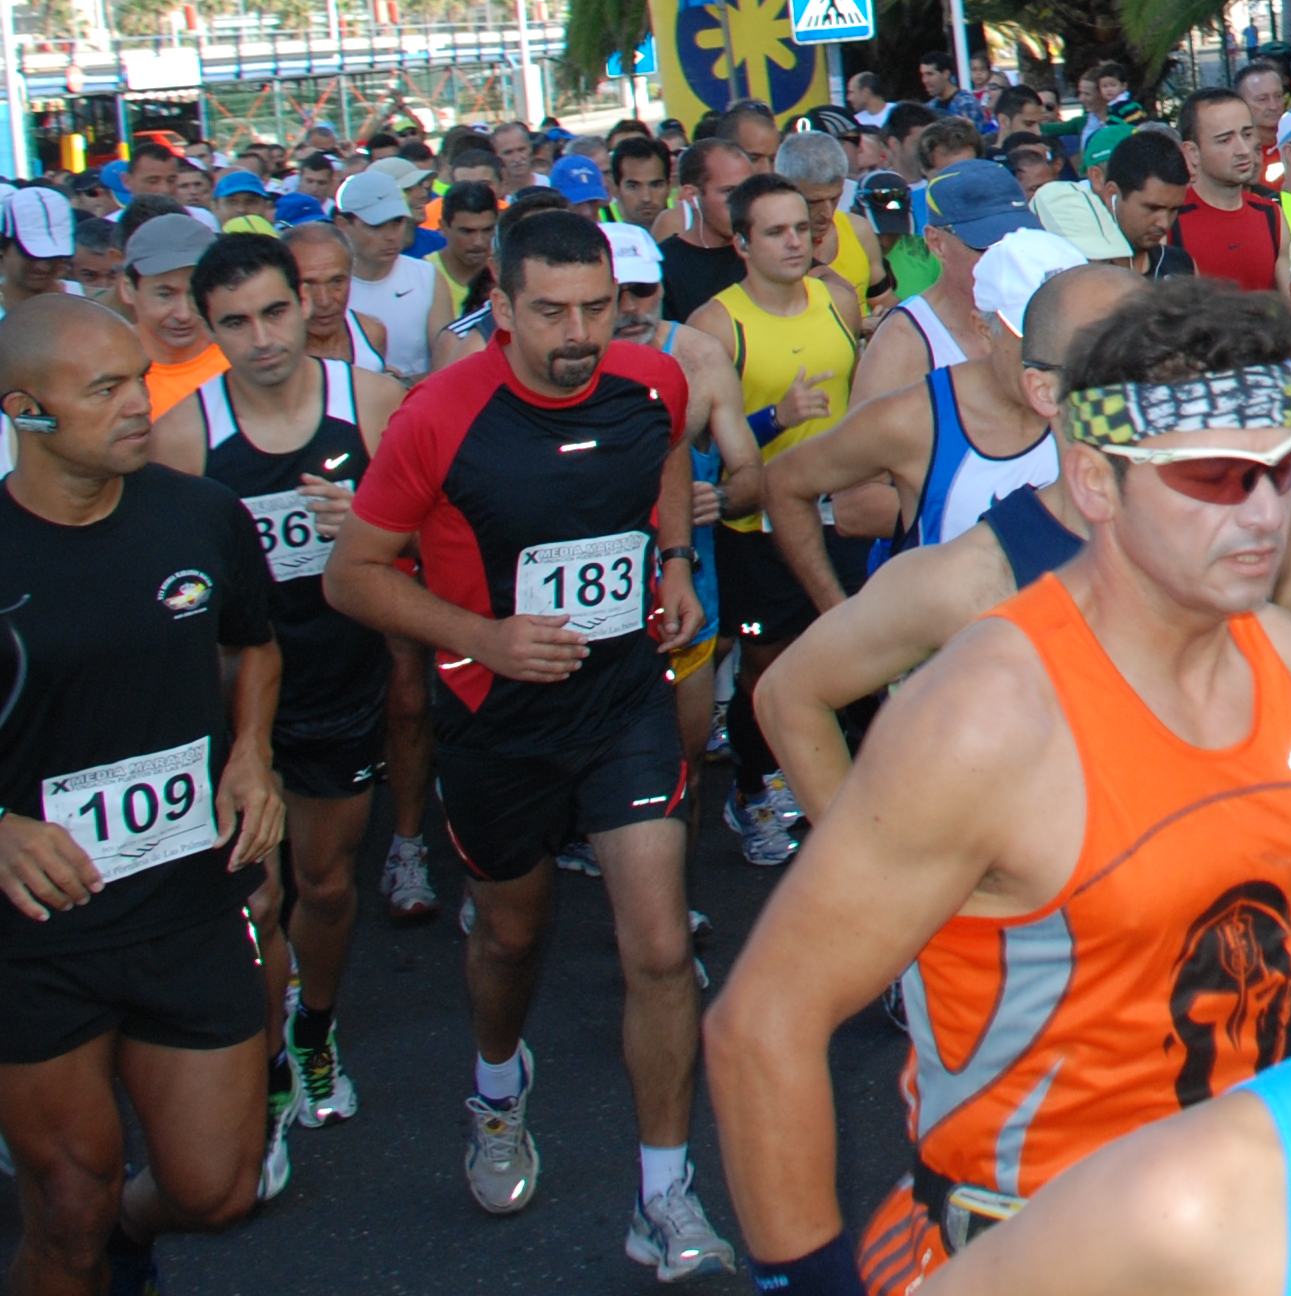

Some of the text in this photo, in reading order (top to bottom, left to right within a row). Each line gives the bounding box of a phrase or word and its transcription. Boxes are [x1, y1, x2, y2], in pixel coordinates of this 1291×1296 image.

[522, 549, 540, 566] X
[543, 556, 634, 610] 183
[51, 743, 205, 796] X MEDIA MARATÓN
[79, 772, 197, 843] 109
